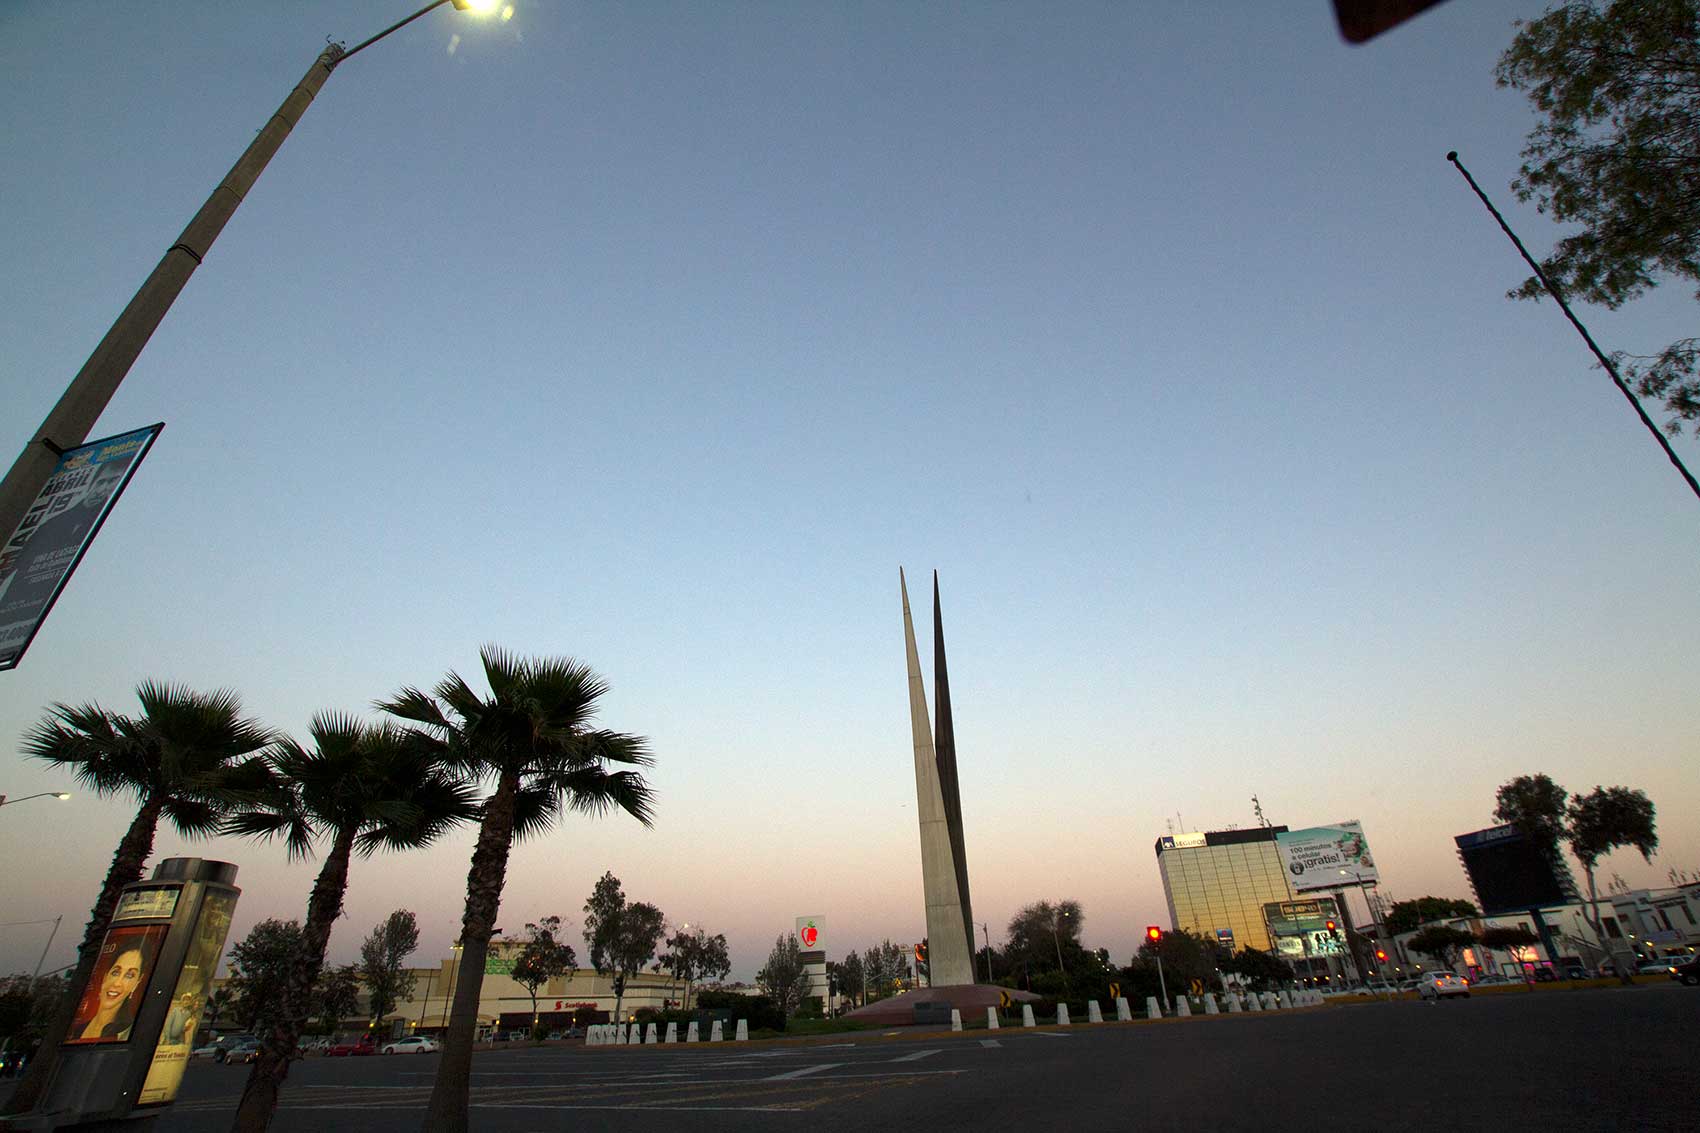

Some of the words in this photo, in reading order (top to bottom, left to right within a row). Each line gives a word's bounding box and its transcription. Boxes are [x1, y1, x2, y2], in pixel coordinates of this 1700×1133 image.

[38, 473, 90, 498] ABRIL
[47, 492, 72, 514] 19
[1303, 843, 1332, 851] minutos
[1297, 851, 1321, 860] celular
[565, 1001, 598, 1009] Scotiabank
